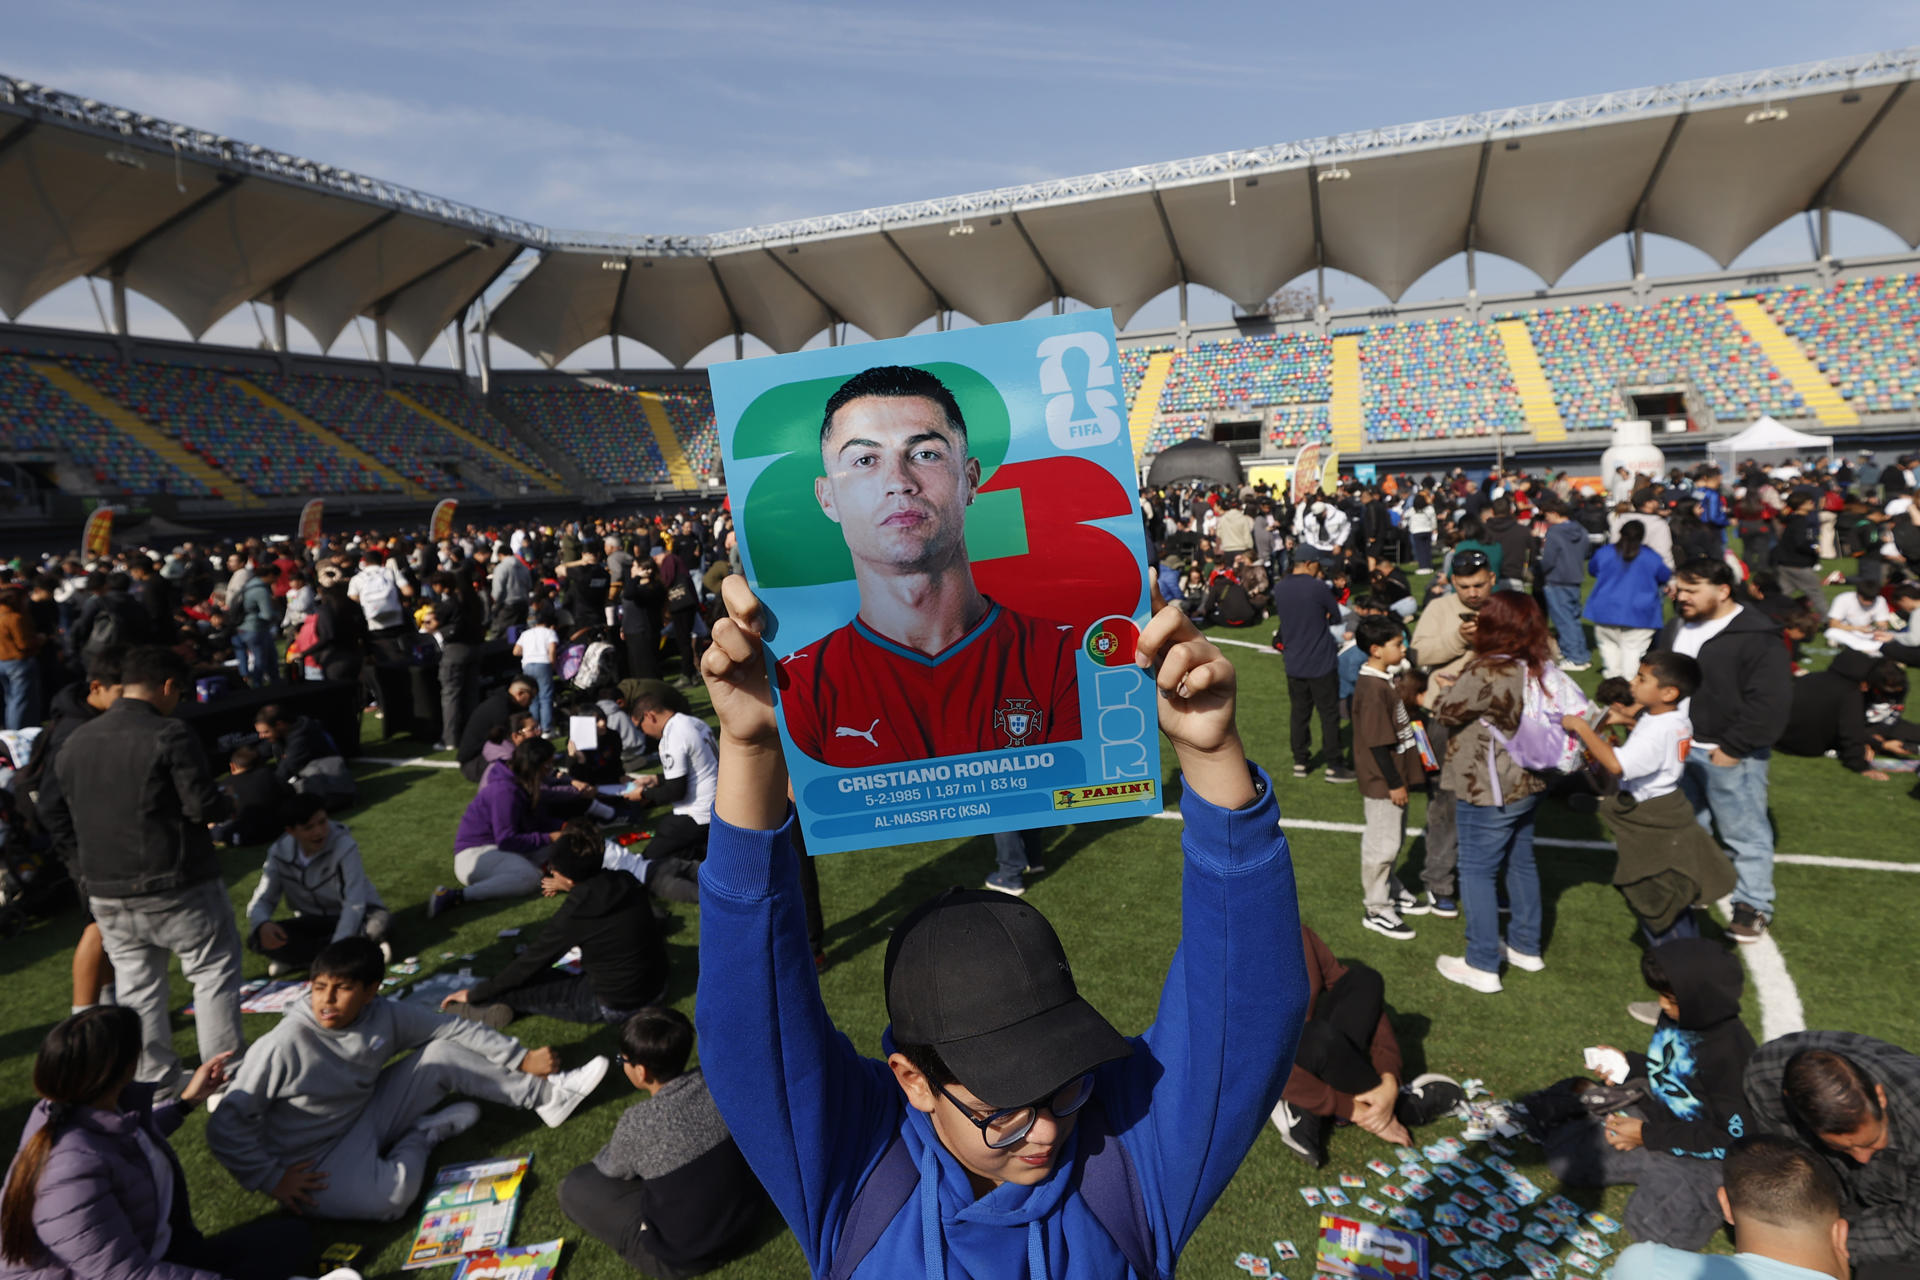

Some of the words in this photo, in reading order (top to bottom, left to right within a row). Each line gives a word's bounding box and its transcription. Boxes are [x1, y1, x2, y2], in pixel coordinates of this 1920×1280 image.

[1069, 423, 1103, 439] FIFA
[1095, 668, 1149, 781] POR
[838, 766, 951, 793] CRISTIANO
[954, 752, 1055, 779] RONALDO
[865, 788, 921, 806] 5-2-1985
[935, 783, 960, 799] 1,87
[963, 782, 976, 794] m
[990, 778, 1008, 790] 83
[1010, 776, 1027, 790] kg
[1082, 783, 1150, 799] PANINI
[874, 808, 938, 828] AL-NASSR
[940, 807, 956, 820] FC
[958, 803, 991, 819] (KSA)
